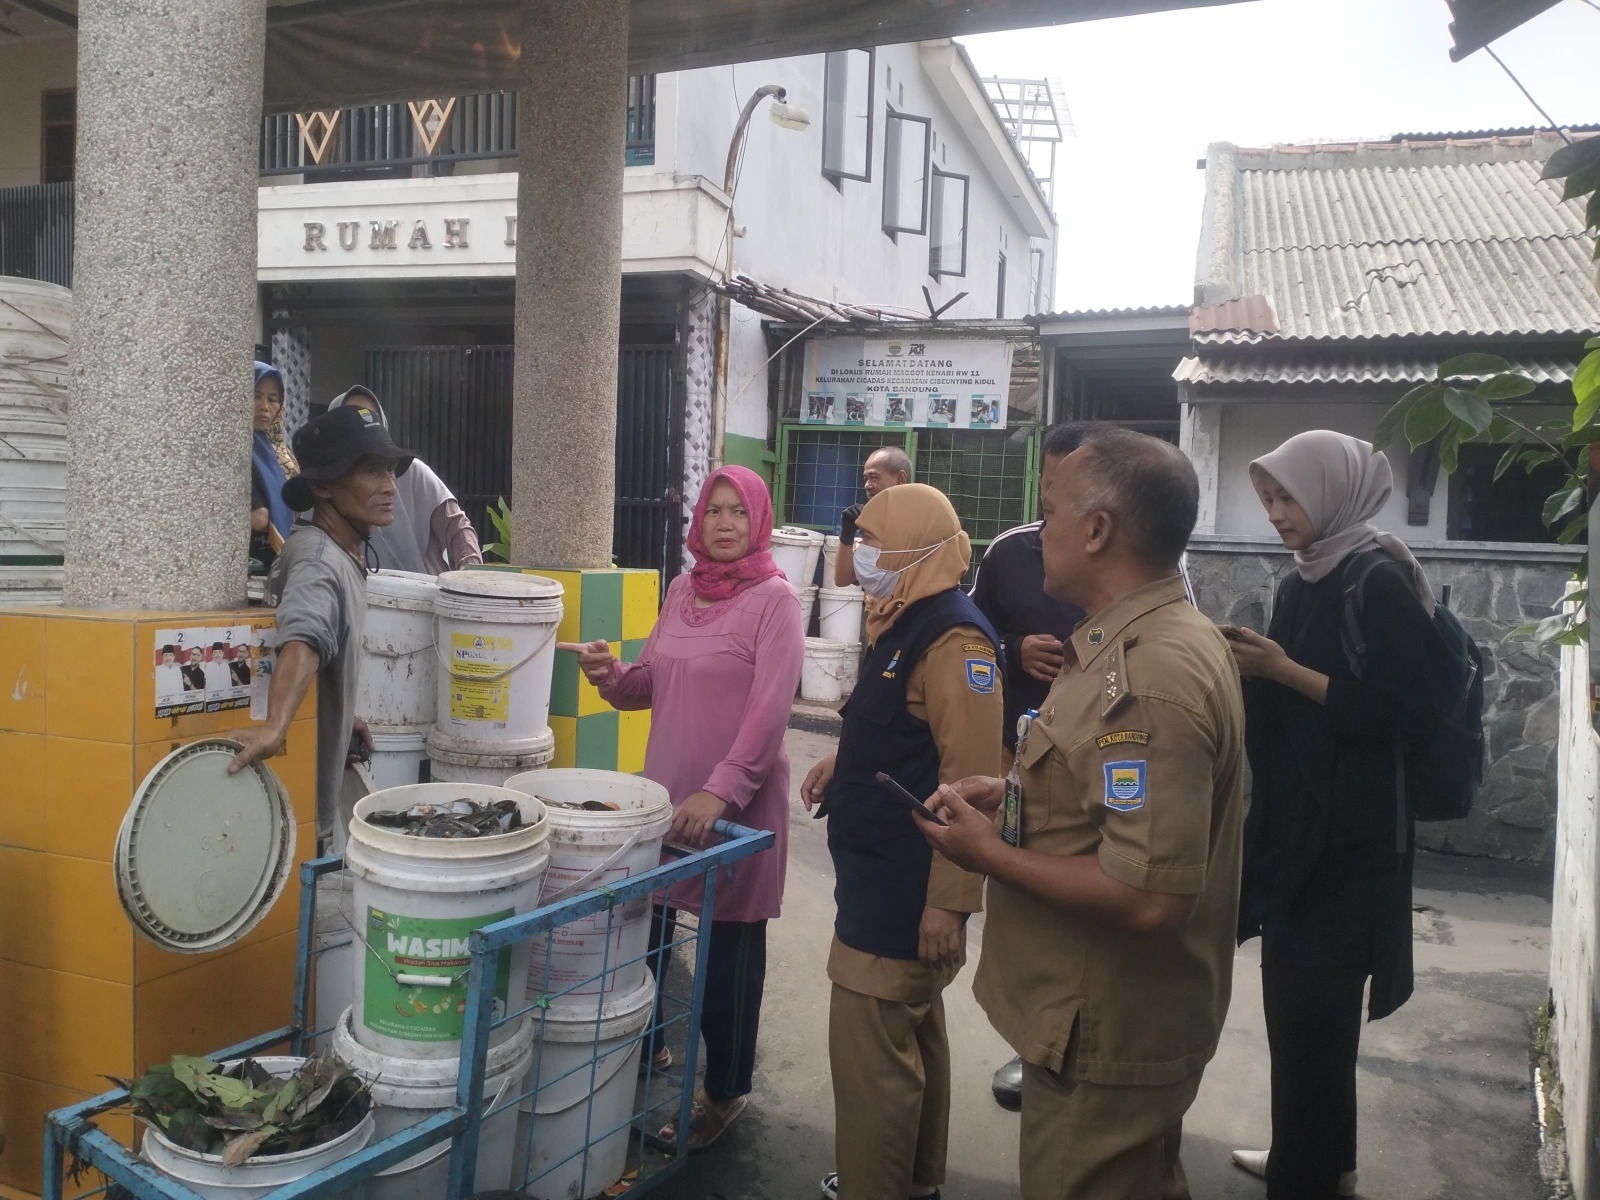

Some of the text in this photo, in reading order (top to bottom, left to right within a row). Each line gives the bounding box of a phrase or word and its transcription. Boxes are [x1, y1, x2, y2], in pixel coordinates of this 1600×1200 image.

[303, 218, 471, 250] RUMAH
[858, 359, 953, 368] SELAMAT DATANG
[840, 368, 864, 376] LOKUS
[815, 376, 855, 384] KELURAHAN
[856, 377, 885, 385] CICADAS
[886, 377, 928, 385] KECAMATAN
[929, 378, 973, 386] CIBEUNYING
[867, 385, 938, 394] KOTA BANDUNG
[177, 632, 184, 643] 2
[226, 630, 232, 641] 2
[1110, 732, 1124, 743] KOTA
[404, 958, 426, 966] Wadah
[440, 958, 470, 967] Makanan
